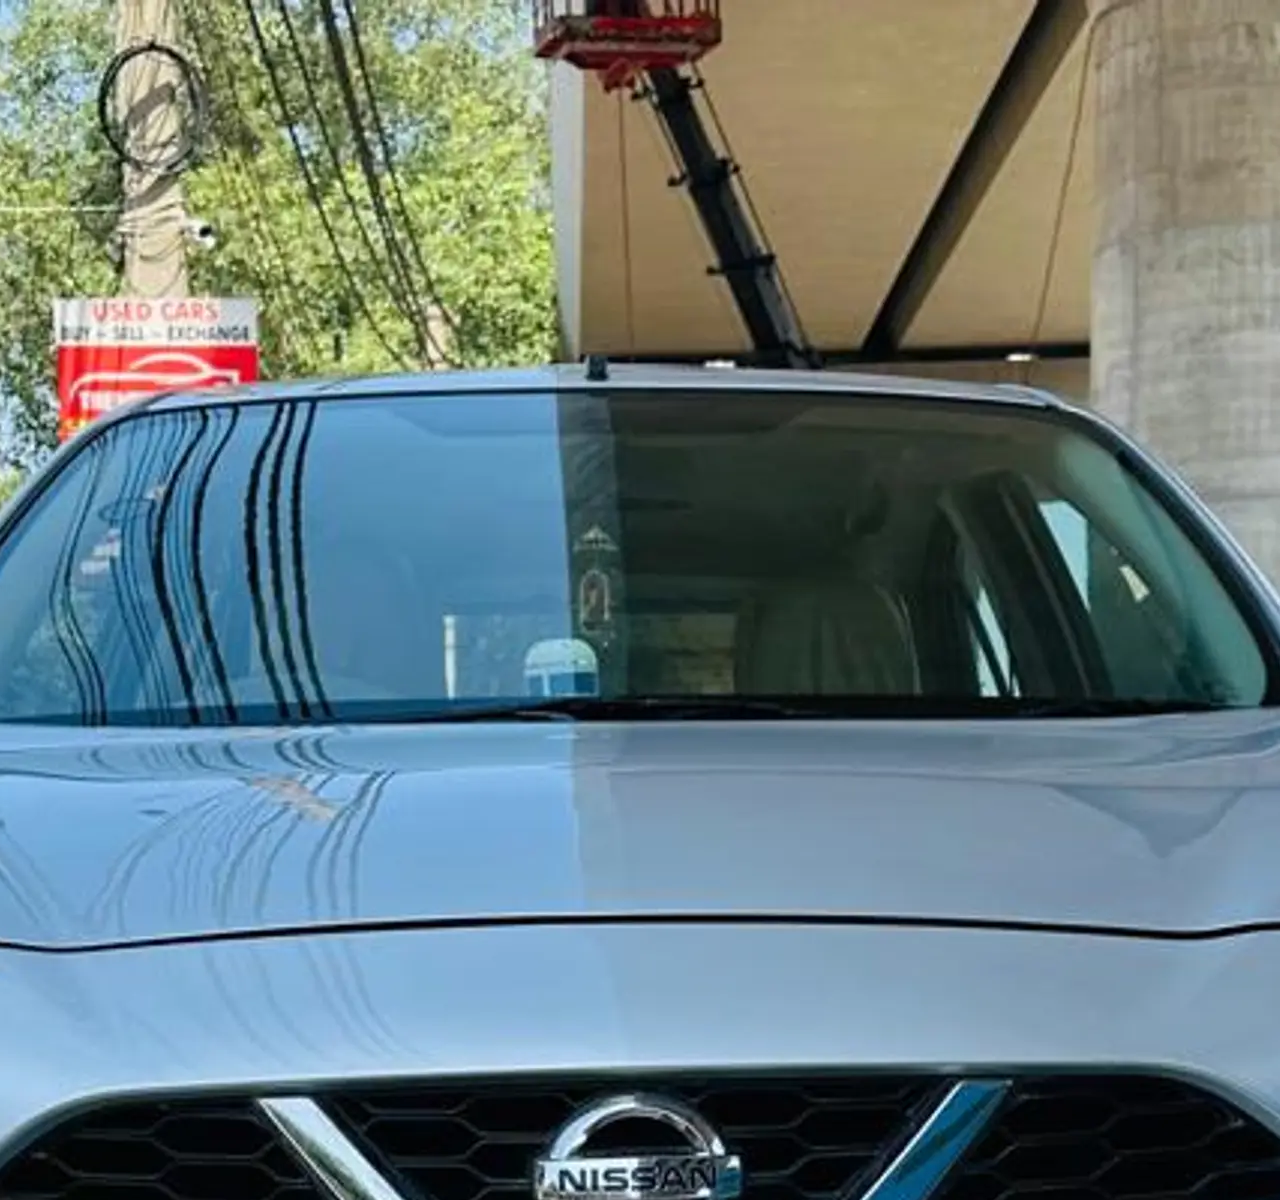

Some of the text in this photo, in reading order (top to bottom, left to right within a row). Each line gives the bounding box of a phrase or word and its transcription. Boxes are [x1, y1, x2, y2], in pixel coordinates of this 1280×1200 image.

[93, 301, 219, 322] USED CARS
[61, 324, 249, 341] BUY SELL EXCHANGE
[558, 1160, 716, 1192] NISSAN
